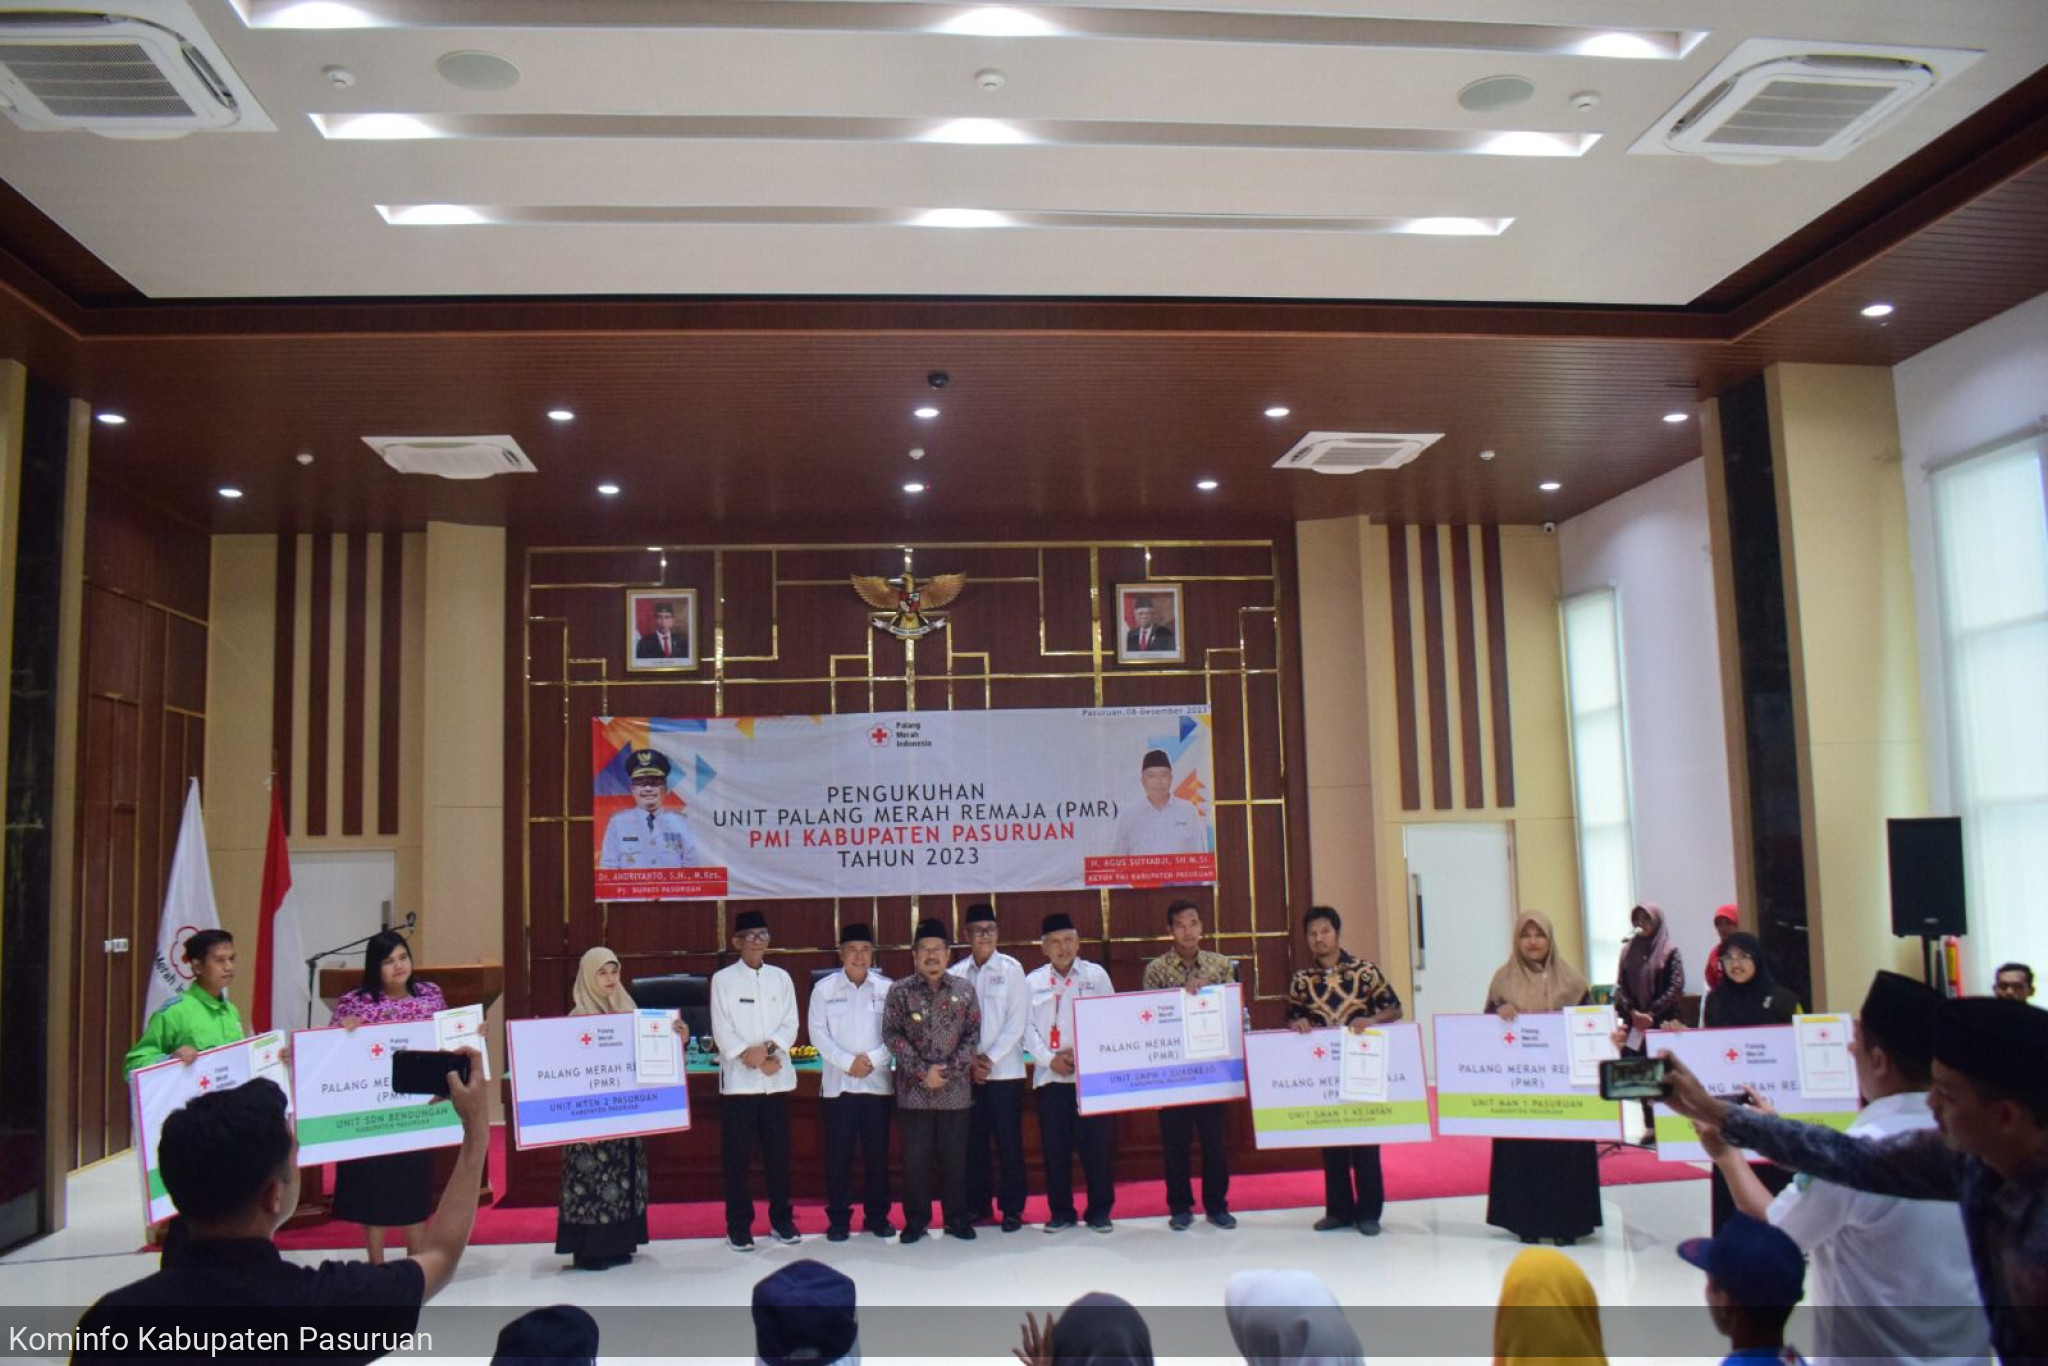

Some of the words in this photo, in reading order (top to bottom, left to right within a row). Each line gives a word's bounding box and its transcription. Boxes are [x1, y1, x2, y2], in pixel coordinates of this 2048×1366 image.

[896, 721, 921, 730] Palang
[827, 783, 985, 804] PENGUKUHAN
[713, 809, 767, 827] UNIT
[778, 807, 863, 825] PALANG
[874, 805, 950, 823] MERAH
[961, 803, 1046, 821] REMAJA
[1056, 800, 1119, 821] (PMR)
[750, 829, 790, 848] PMI
[803, 826, 939, 847] KABUPATEN
[952, 822, 1075, 843] PASURUAN
[837, 849, 915, 868] TAHUN
[927, 847, 980, 866] 2023
[1099, 1041, 1141, 1053] PALANG
[1145, 1037, 1181, 1049] MERAH
[1148, 1051, 1180, 1063] (PMR)
[538, 1067, 580, 1080] PALANG
[586, 1064, 622, 1075] MERAH
[1458, 1063, 1503, 1074] PALANG
[1507, 1063, 1547, 1074] MERAH
[321, 1078, 368, 1094] PALANG
[589, 1078, 621, 1090] (PMR)
[1271, 1076, 1315, 1088] PALANG
[1510, 1077, 1545, 1089] (PMR)
[1731, 1081, 1775, 1091] MRAH
[550, 1102, 571, 1112] UNIT
[613, 1093, 658, 1105] PASURUAN
[336, 1118, 361, 1129] UNIT
[388, 1107, 448, 1121] BENDUNGAN
